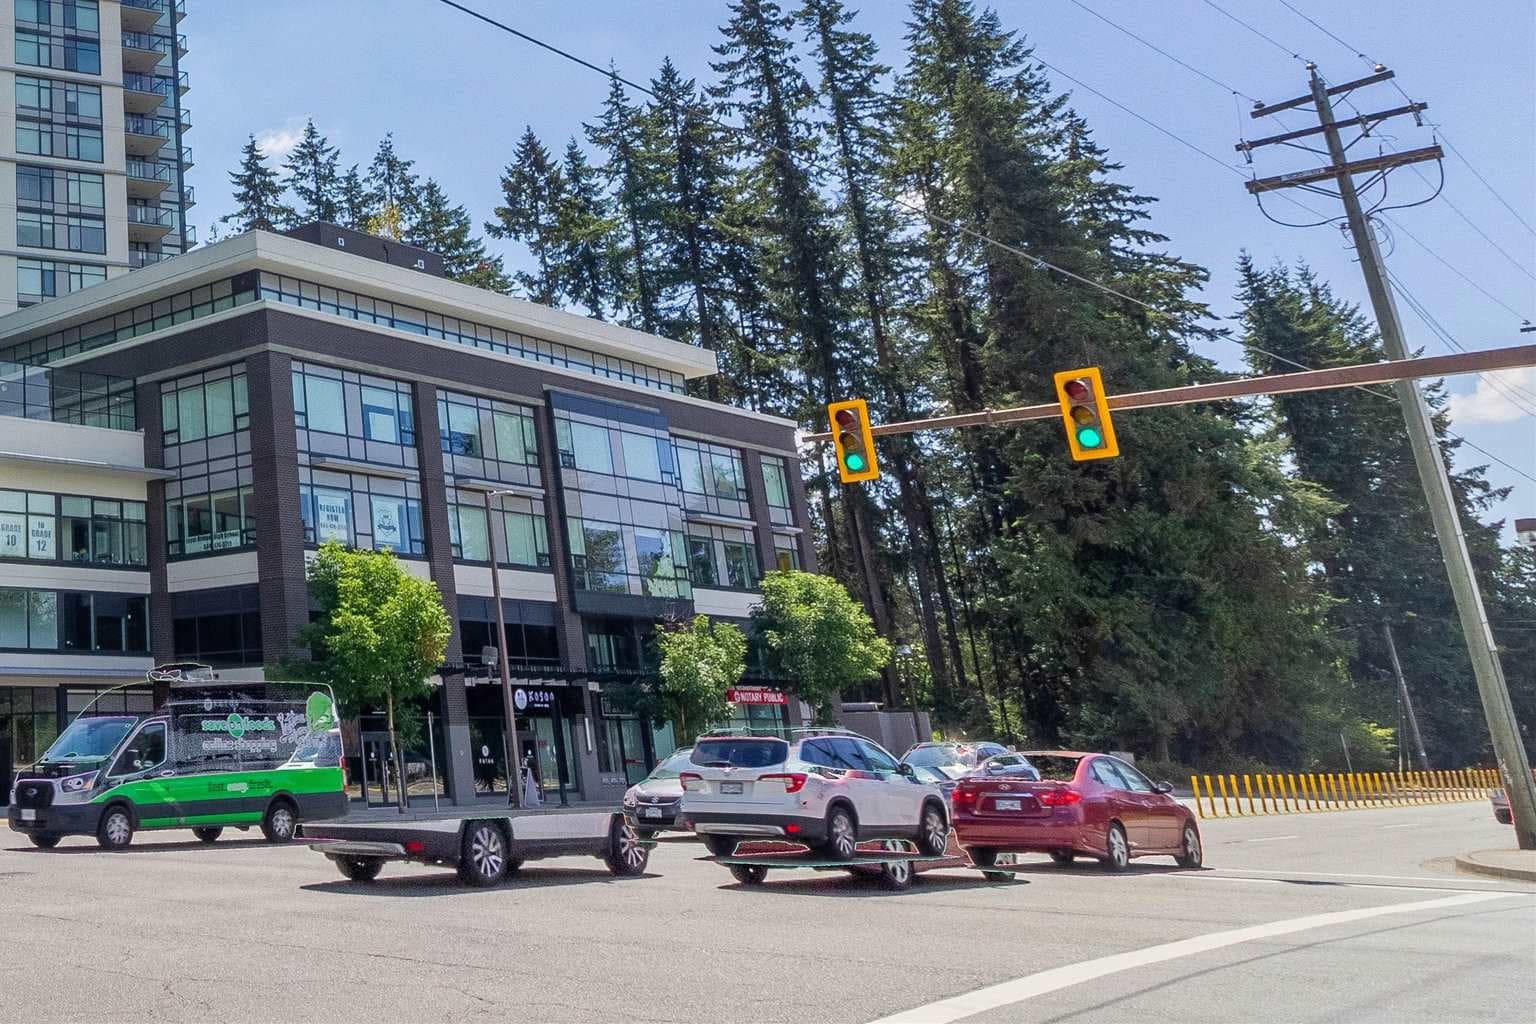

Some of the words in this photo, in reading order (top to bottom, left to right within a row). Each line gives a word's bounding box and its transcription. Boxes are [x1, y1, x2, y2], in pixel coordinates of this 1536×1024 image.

[5, 534, 17, 546] 10
[36, 539, 47, 552] 12
[740, 691, 762, 703] NOTARY
[763, 691, 784, 703] PUBLIC
[244, 716, 275, 731] foods
